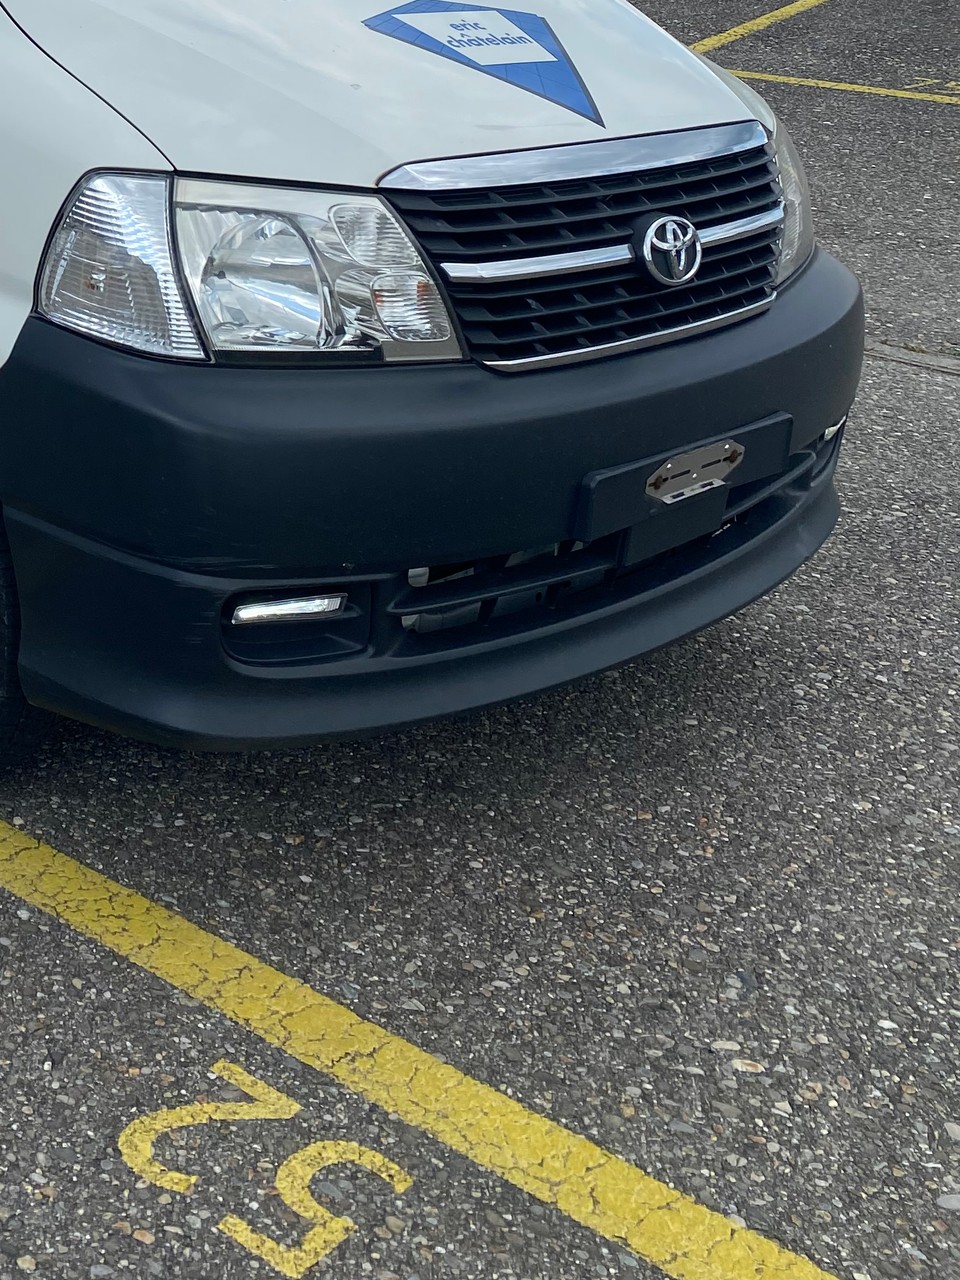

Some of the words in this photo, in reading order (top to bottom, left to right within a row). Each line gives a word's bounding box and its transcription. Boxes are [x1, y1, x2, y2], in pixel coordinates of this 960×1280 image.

[449, 19, 488, 32] eric
[446, 31, 533, 49] châtelain
[117, 1058, 414, 1280] 52
